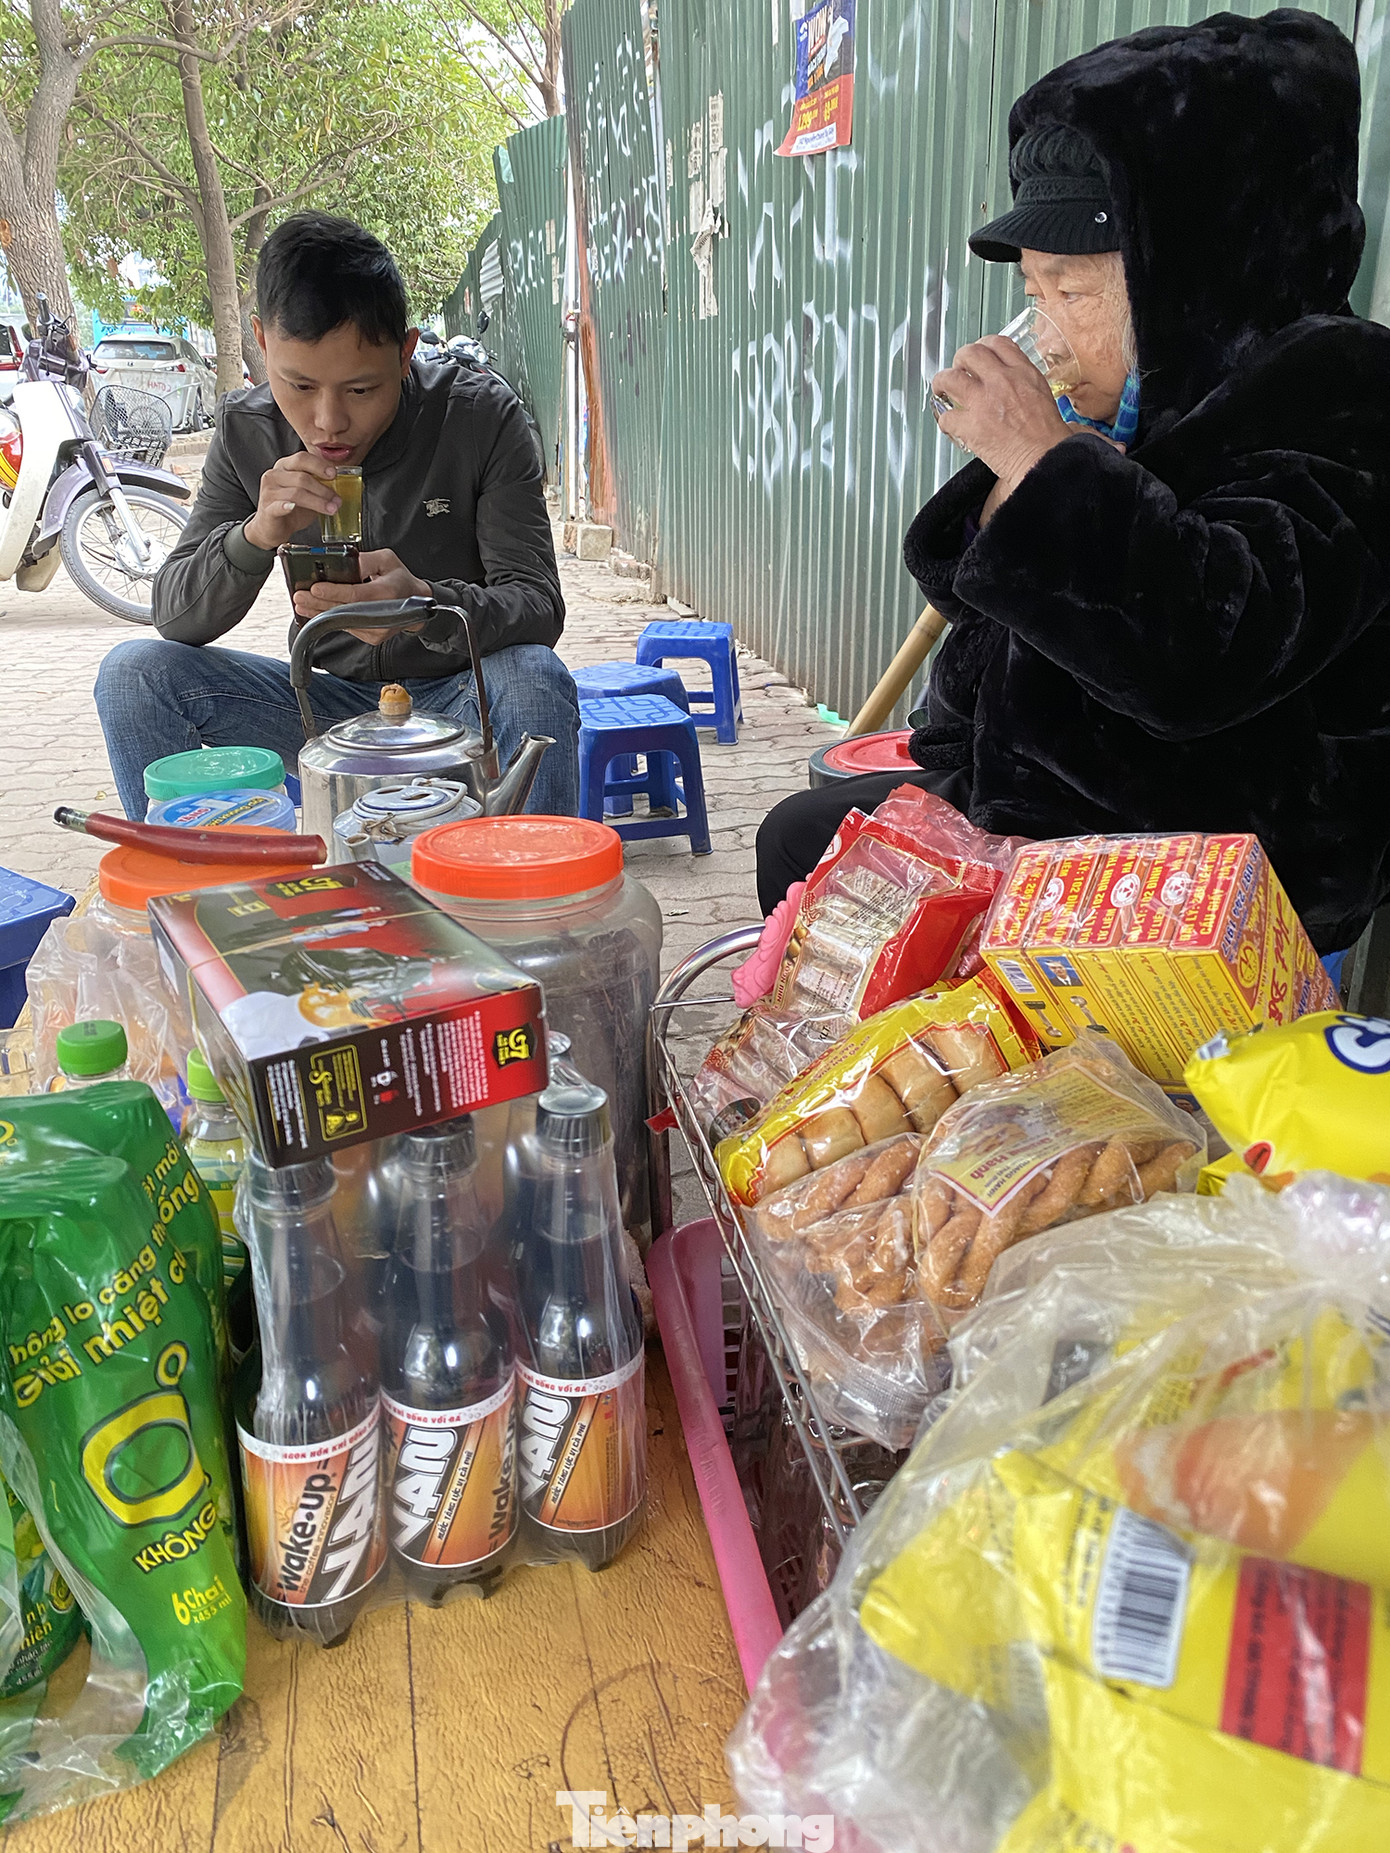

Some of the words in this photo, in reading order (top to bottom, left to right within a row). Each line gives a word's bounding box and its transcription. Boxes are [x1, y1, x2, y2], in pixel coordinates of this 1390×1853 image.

[1070, 876, 1085, 894] 102
[1148, 865, 1164, 890] ĐÌNH
[1240, 862, 1255, 892] 097
[1092, 892, 1106, 910] 102
[1232, 887, 1247, 919] 244
[1200, 914, 1215, 936] CẦU
[1221, 918, 1237, 957] 1917
[62, 1300, 95, 1325] lo
[98, 1242, 158, 1305] căng
[12, 1347, 83, 1409] Giải
[82, 1276, 171, 1366] nhiệt
[516, 1388, 573, 1503] 247
[550, 1482, 562, 1505] NƯỚC
[556, 1467, 568, 1487] TĂNG
[563, 1455, 576, 1471] LỰC
[572, 1434, 582, 1452] CÀ
[392, 1425, 459, 1551] 247
[450, 1486, 464, 1503] LỰC
[132, 1501, 218, 1574] KHÔNG
[303, 1543, 321, 1576] coffee
